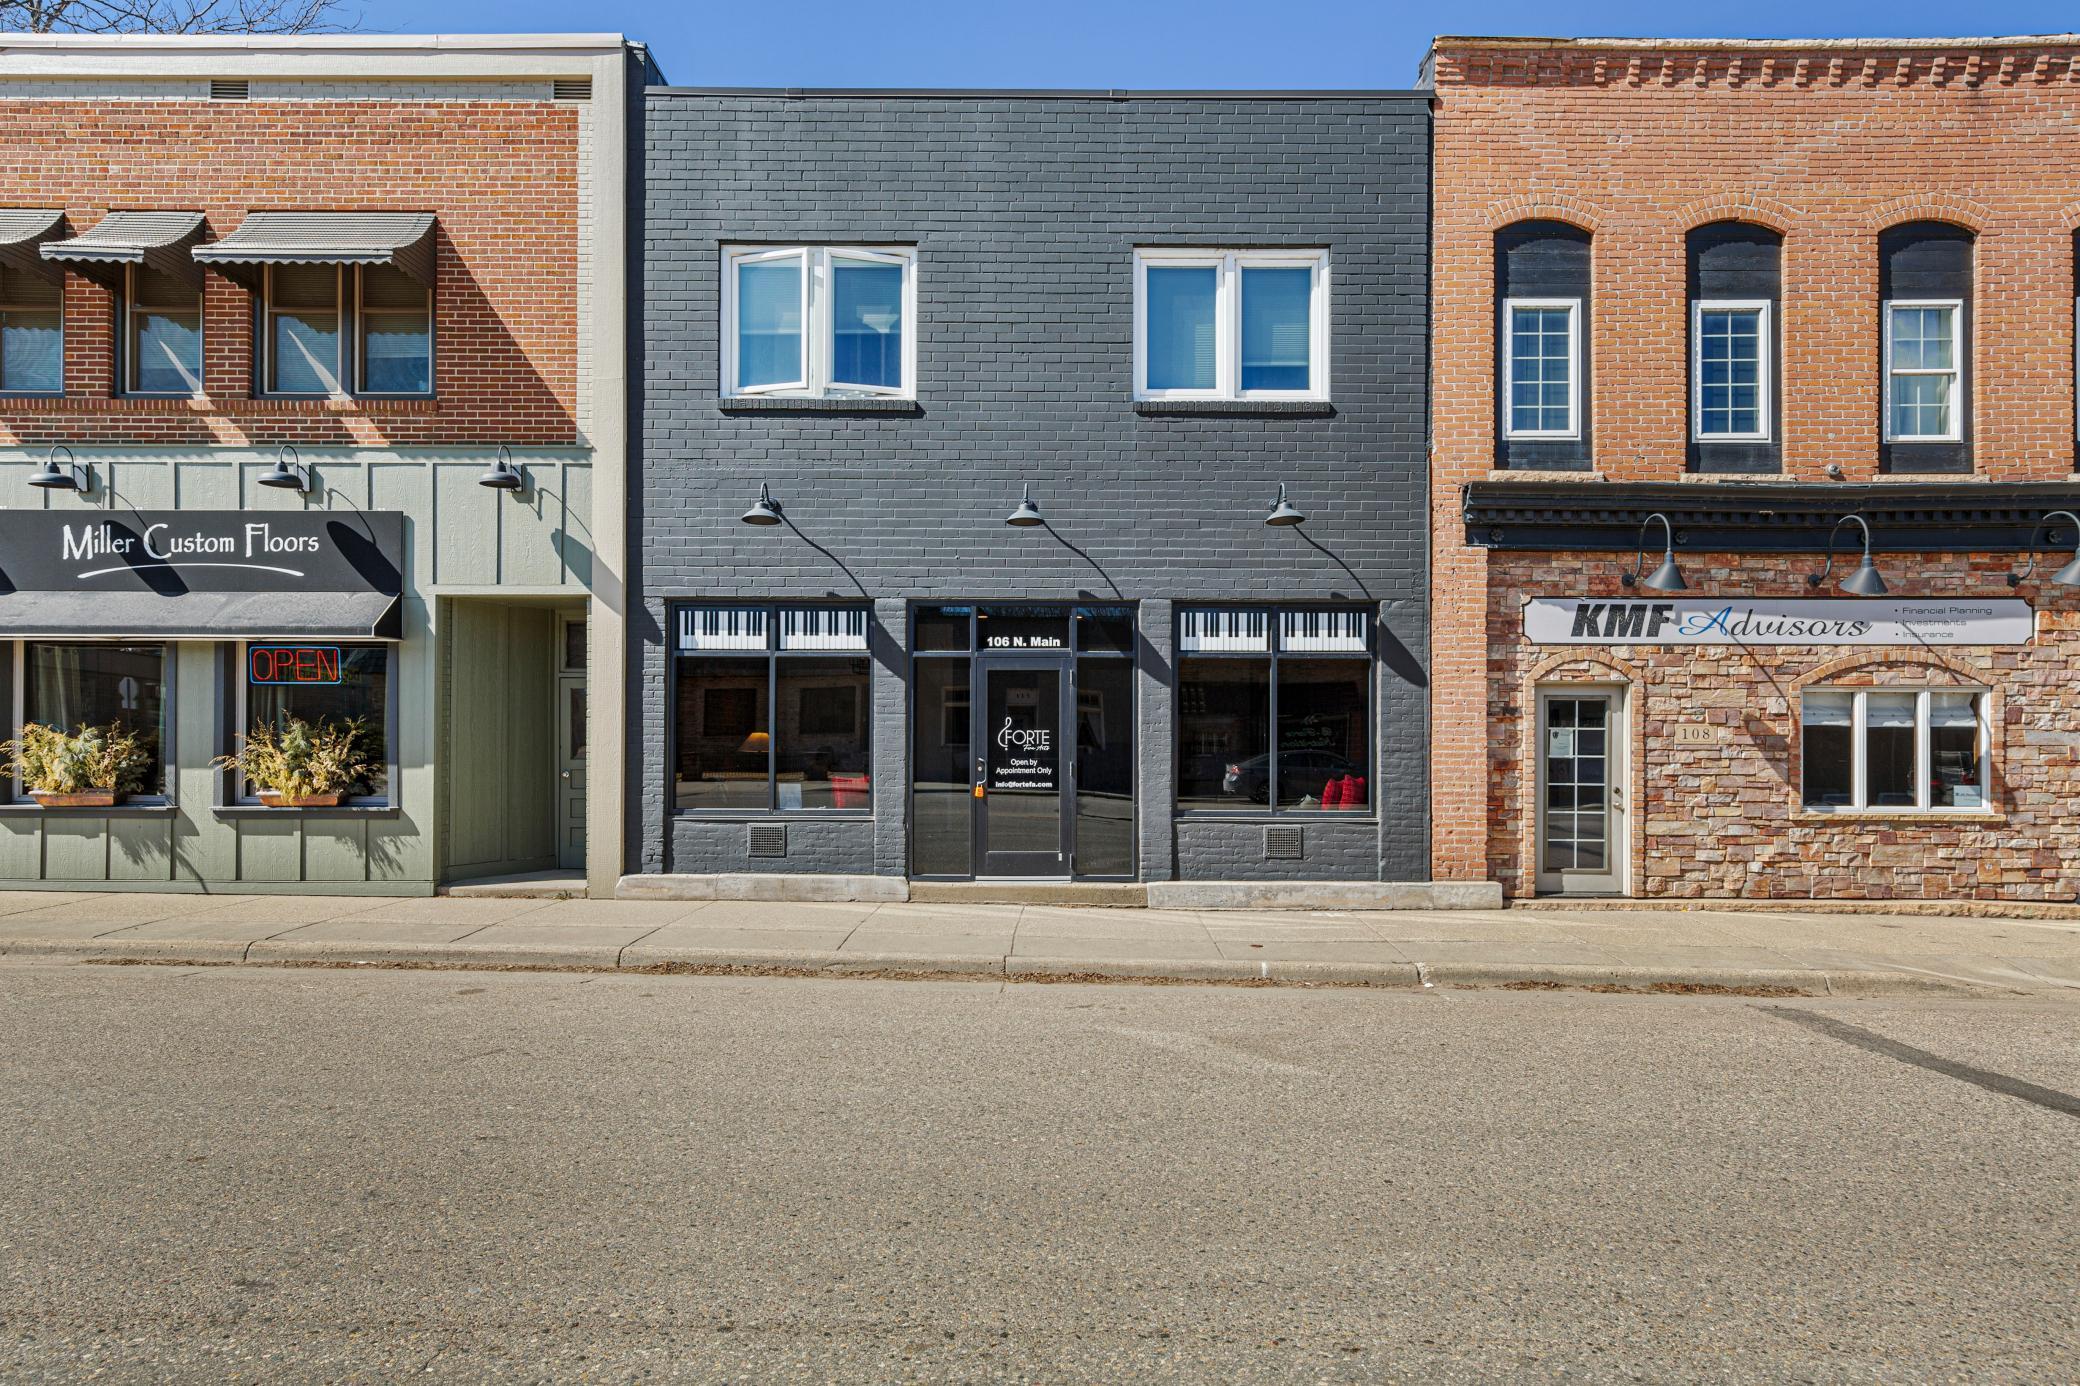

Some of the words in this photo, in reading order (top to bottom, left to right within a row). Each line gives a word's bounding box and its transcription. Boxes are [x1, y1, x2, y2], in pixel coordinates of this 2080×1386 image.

[62, 524, 135, 560] Miller
[143, 523, 235, 560] Custom
[245, 522, 320, 558] Floors
[1902, 607, 1946, 615] Financial
[1949, 607, 1993, 616] Planning
[1570, 604, 1673, 638] KMF
[1678, 606, 1873, 637] Advisors
[1902, 619, 1967, 627] Investments
[987, 636, 1010, 647] 106
[1013, 636, 1027, 647] N.
[1030, 636, 1061, 647] Main
[252, 649, 338, 681] OPEN
[1004, 729, 1050, 745] FORTE
[1682, 728, 1710, 740] 108
[1010, 758, 1029, 766] Open
[1029, 758, 1038, 767] by
[995, 767, 1036, 775] Appointment
[1036, 766, 1052, 775] Only
